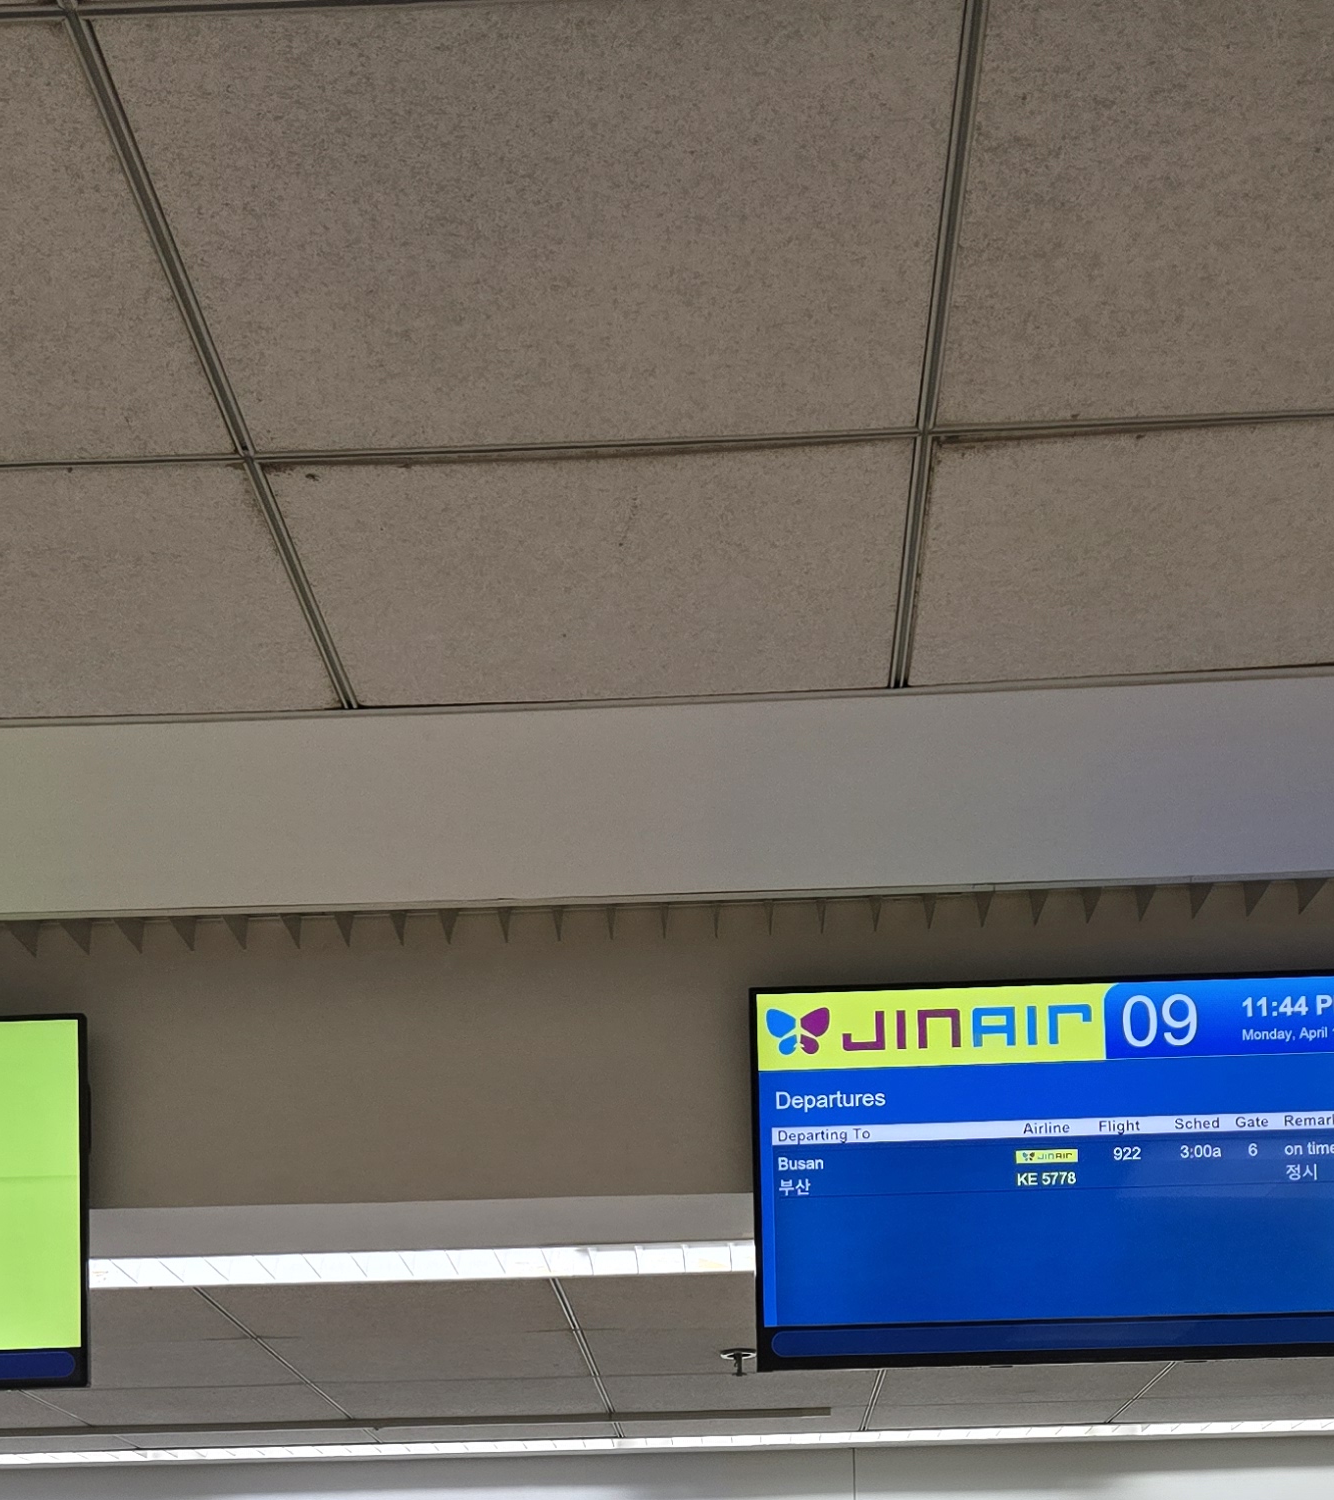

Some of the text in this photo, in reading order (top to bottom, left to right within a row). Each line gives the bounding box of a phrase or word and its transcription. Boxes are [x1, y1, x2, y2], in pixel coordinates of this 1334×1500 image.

[1242, 996, 1309, 1018] 11:44
[1121, 993, 1198, 1047] 09
[1242, 1027, 1295, 1042] Monday,
[1299, 1026, 1328, 1040] April
[775, 1089, 886, 1110] Departures
[777, 1127, 848, 1143] Departing
[853, 1126, 871, 1140] To
[1023, 1120, 1071, 1135] Airline
[1098, 1118, 1140, 1135] Flight
[1174, 1116, 1221, 1130] Sched
[1235, 1115, 1269, 1129] Gate
[1113, 1146, 1142, 1161] 922
[1180, 1143, 1222, 1159] 3:00a
[1248, 1142, 1258, 1157] 6
[1284, 1143, 1302, 1156] on
[778, 1155, 824, 1171] Busan
[1017, 1171, 1076, 1186] KE 5778
[1285, 1163, 1317, 1181] 정시
[779, 1178, 811, 1196] 부산
